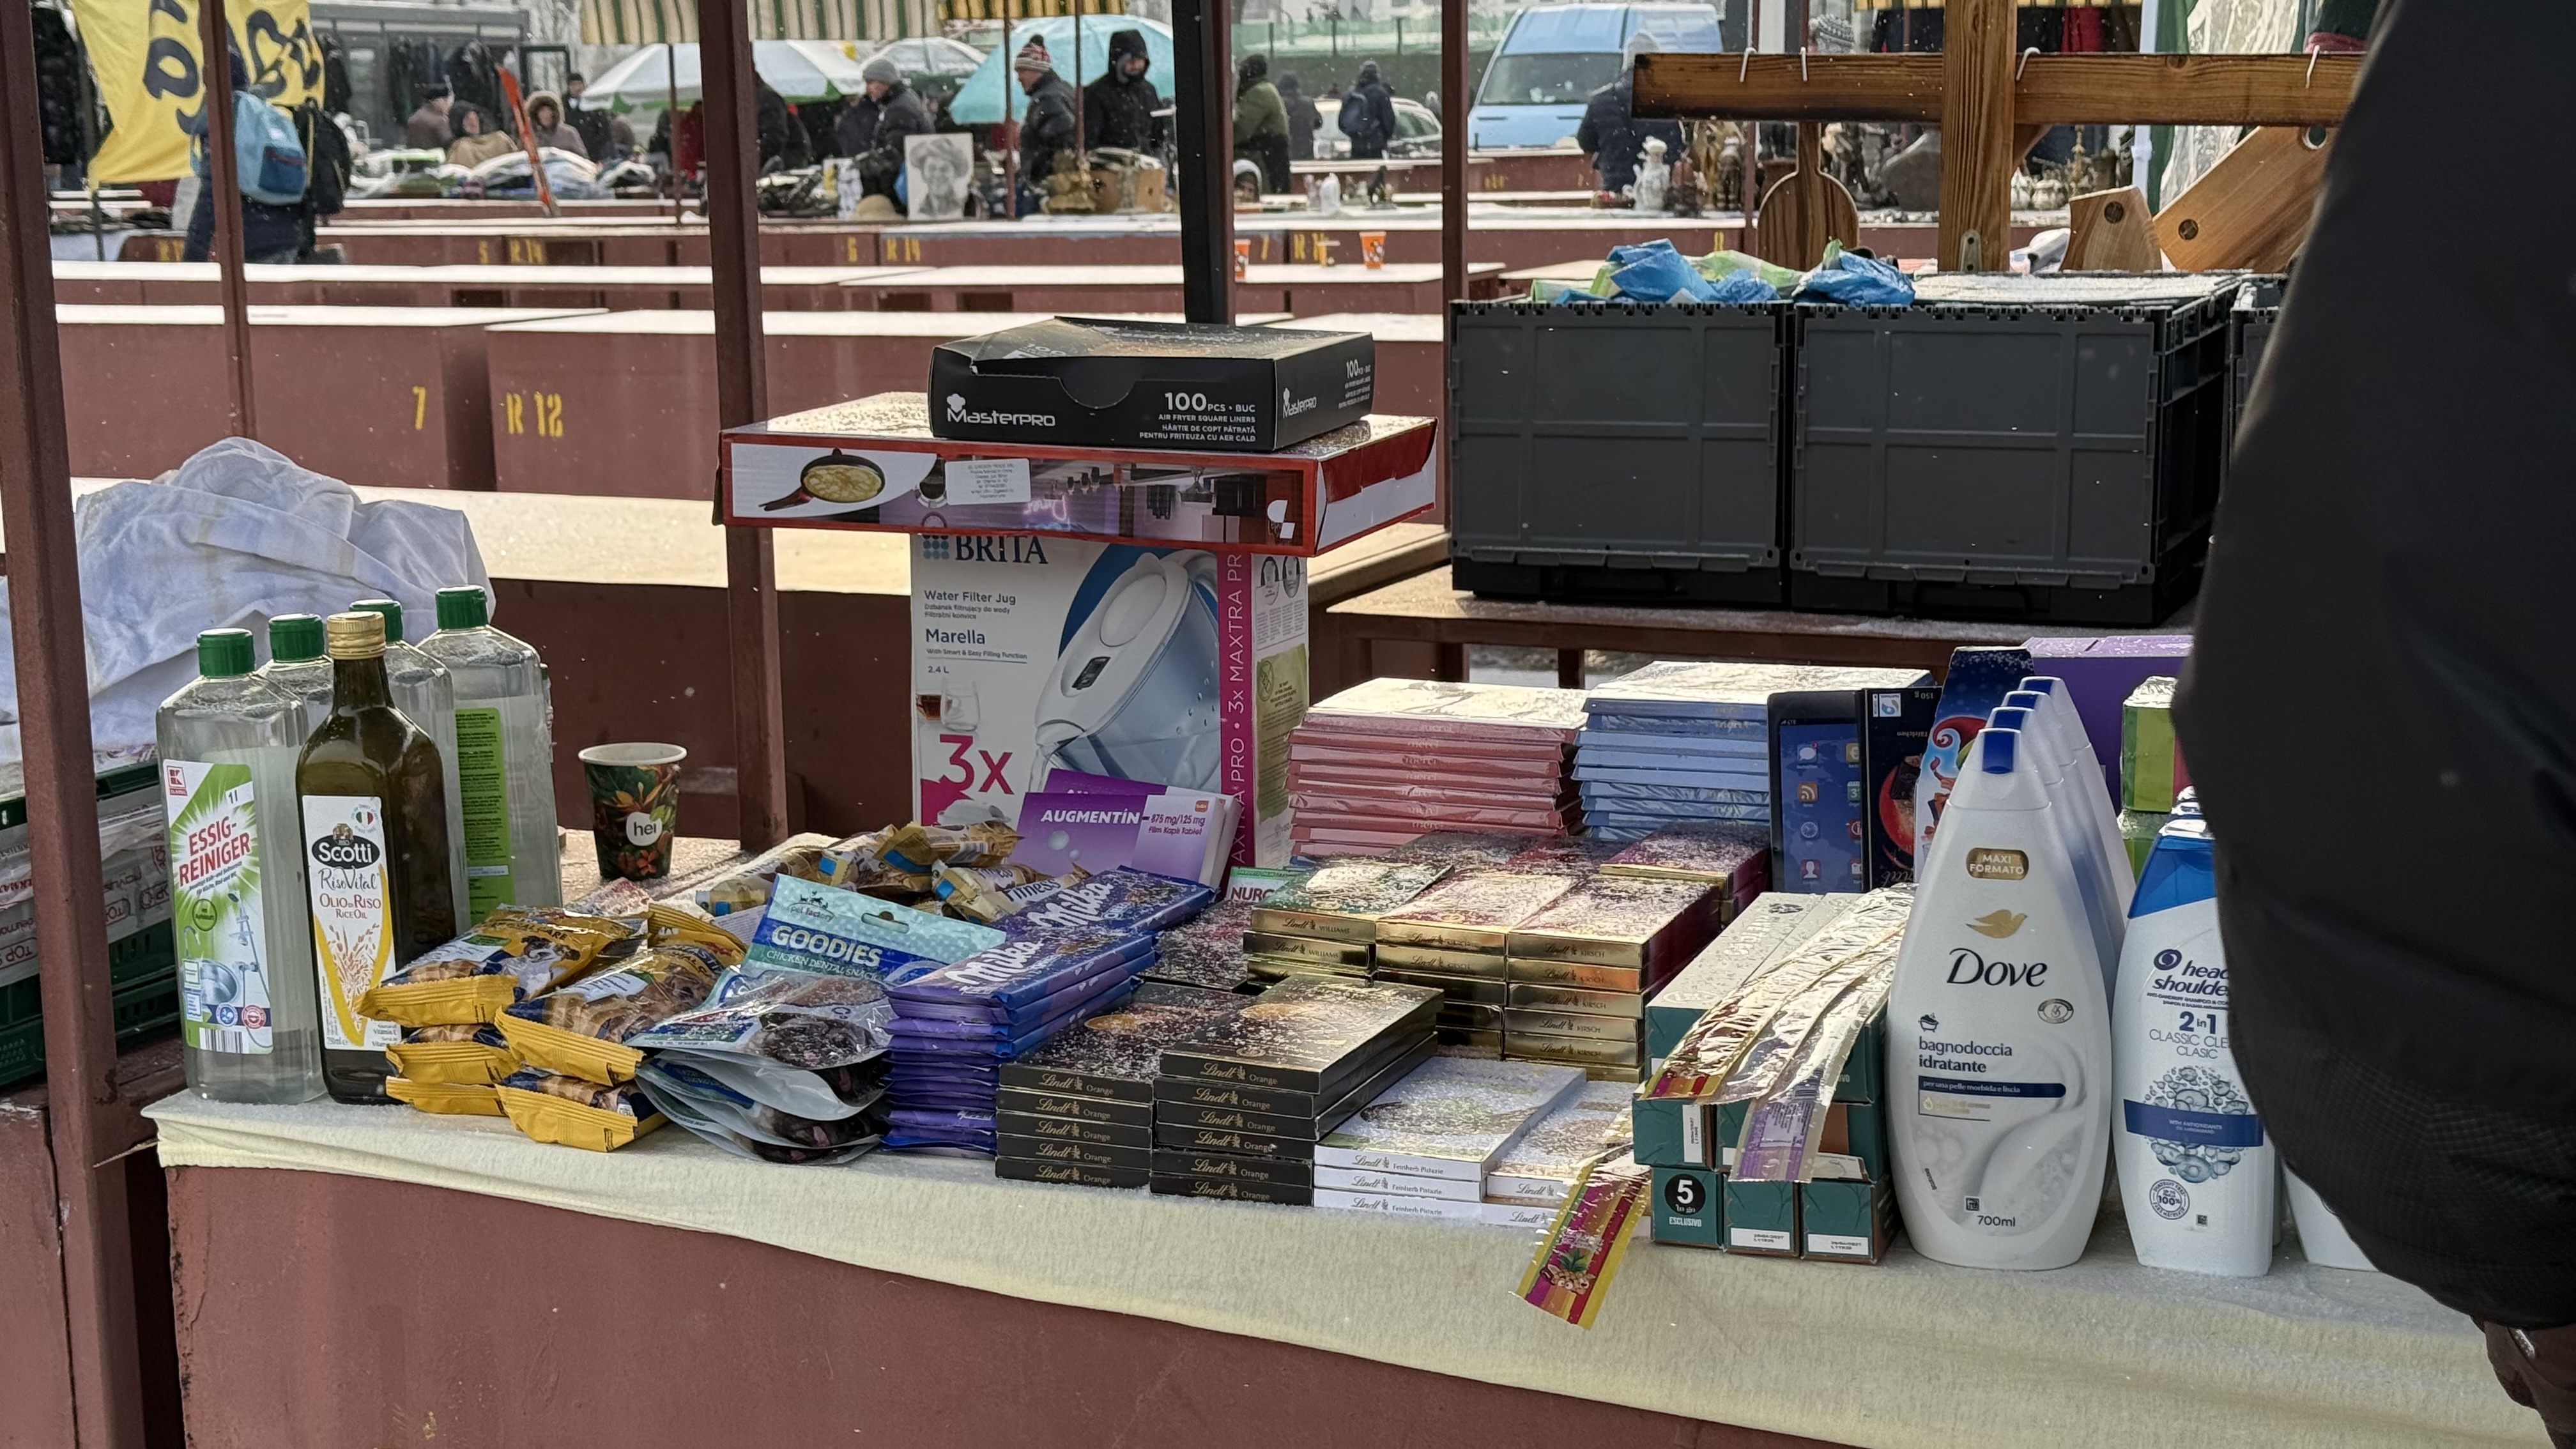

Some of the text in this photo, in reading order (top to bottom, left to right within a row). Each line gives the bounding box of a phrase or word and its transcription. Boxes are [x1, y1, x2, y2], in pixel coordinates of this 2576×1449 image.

[413, 387, 425, 431] 7
[507, 392, 563, 438] R 12
[1236, 404, 1255, 413] BUC
[956, 535, 1048, 564] BRITA
[924, 590, 1016, 605] Water Filter Jug
[926, 629, 985, 645] Marella
[1227, 554, 1245, 782] PRO 3x MAXTRA PR
[940, 734, 1015, 795] 3x
[634, 822, 656, 836] hei
[1151, 814, 1205, 827] 875 mg/125 mg
[189, 816, 236, 857] ESSIG-
[179, 832, 250, 887] REINIGER
[319, 842, 372, 862] Scotti
[1982, 854, 2011, 864] MAXI
[1970, 864, 2024, 875] FORMATO
[1004, 878, 1061, 902] Fitness
[1027, 880, 1114, 928] Milka
[1282, 917, 1310, 929] Lindt
[772, 926, 882, 967] GOODIES
[1273, 942, 1339, 958] Lindt WILLIAMS
[1544, 943, 1569, 954] Lindt
[766, 950, 845, 974] CHICKEN DENTAL
[944, 936, 1045, 983] Milka
[1412, 955, 1437, 966] Lindt
[1947, 947, 2047, 986] Dove
[1545, 969, 1569, 979] Lindt
[2152, 975, 2228, 997] shoulde
[1545, 995, 1572, 1005] Lindt
[1539, 1018, 1566, 1029] Lindt
[2179, 1011, 2216, 1034] 2 in 1
[1919, 1036, 2012, 1056] bagnodoccia
[2149, 1029, 2228, 1048] CLASSIC CLE
[1540, 1043, 1566, 1054] Lindt
[2177, 1046, 2218, 1059] CLASIC
[1201, 1062, 1278, 1085] Lindt Orange
[1919, 1055, 1986, 1073] idratante
[1039, 1074, 1114, 1096] Lindt Orange
[1949, 1082, 1966, 1091] pelle
[1193, 1087, 1271, 1110] Lindt Orange
[1036, 1098, 1110, 1120] Lindt Orange
[1198, 1110, 1276, 1132] Lindt Orange
[2183, 1121, 2223, 1130] ANTIOXIDANTS
[1036, 1120, 1110, 1142] Lindt Orange
[1195, 1131, 1272, 1152] Lindt Orange
[1036, 1143, 1112, 1163] Lindt Orange
[1352, 1154, 1383, 1169] Lindt
[1036, 1165, 1111, 1184] Lindt Orange
[1191, 1158, 1269, 1180] Lindt Orange
[1192, 1181, 1270, 1201] Lindt Orange
[1352, 1176, 1382, 1189] Lindt
[1518, 1183, 1547, 1197] Lindt
[1676, 1179, 1694, 1204] 5
[1352, 1197, 1382, 1210] Lindt
[1675, 1204, 1685, 1213] to
[1512, 1211, 1542, 1225] Lindt
[1669, 1216, 1702, 1227] ESCLUSIVO
[1977, 1216, 2016, 1227] 700ml
